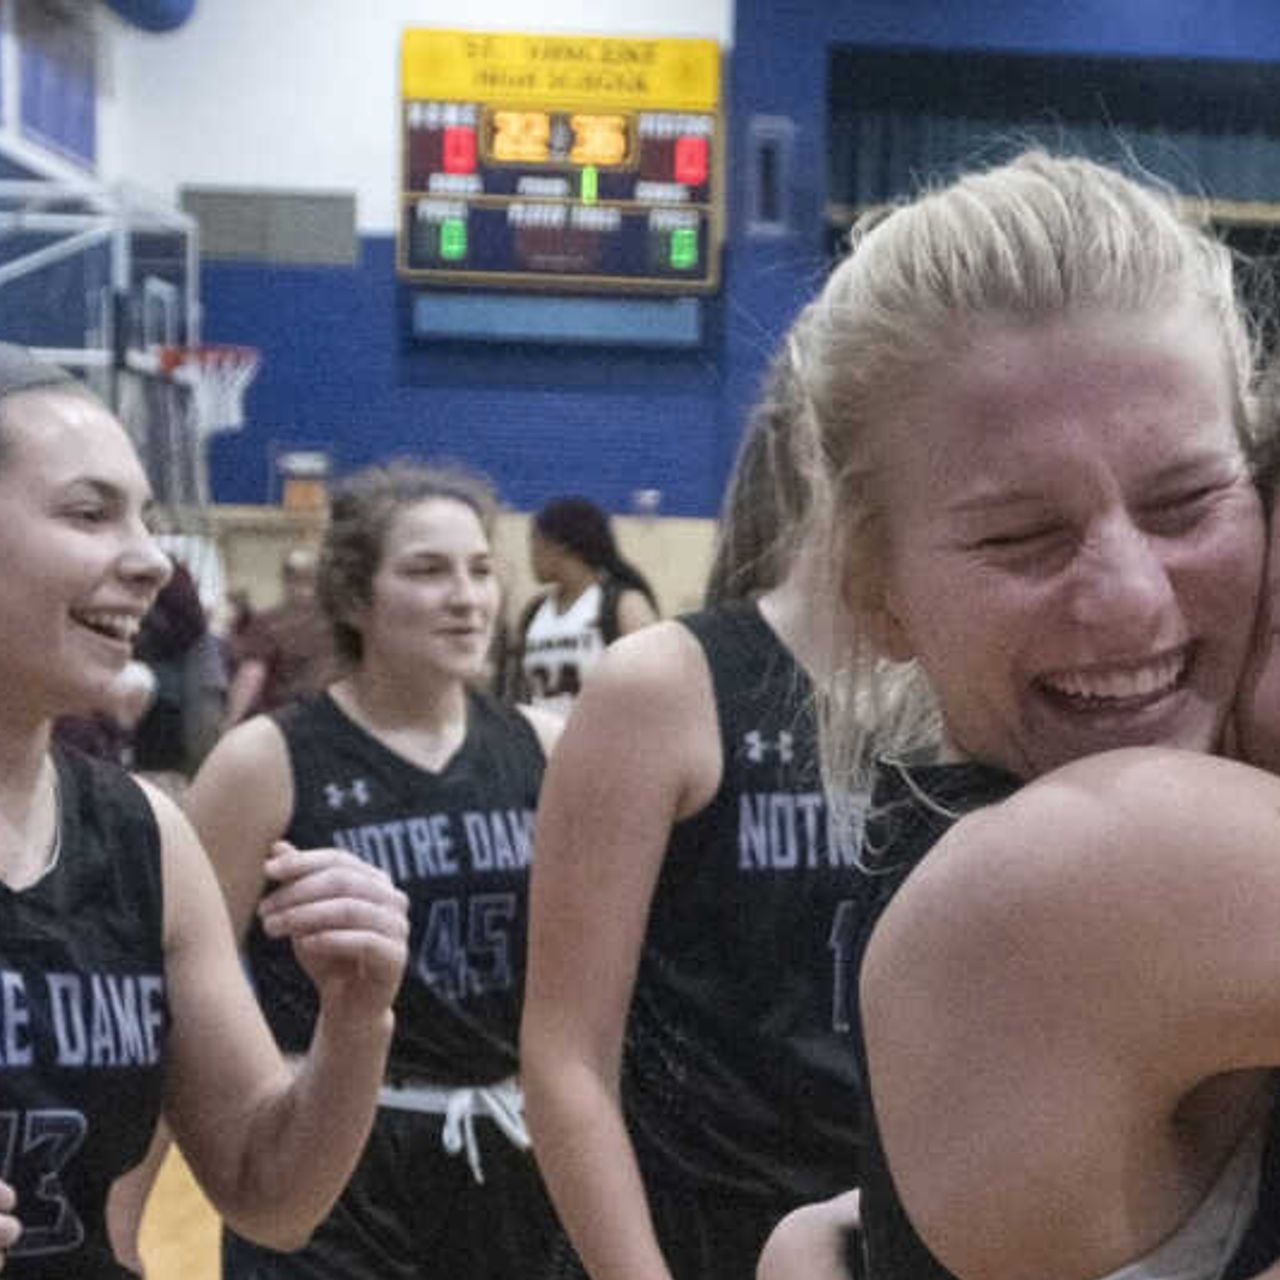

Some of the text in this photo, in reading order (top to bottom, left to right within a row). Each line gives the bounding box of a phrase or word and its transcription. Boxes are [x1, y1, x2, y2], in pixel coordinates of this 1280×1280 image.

[462, 809, 537, 870] DAM
[418, 893, 517, 1003] 45
[46, 971, 163, 1069] DAME
